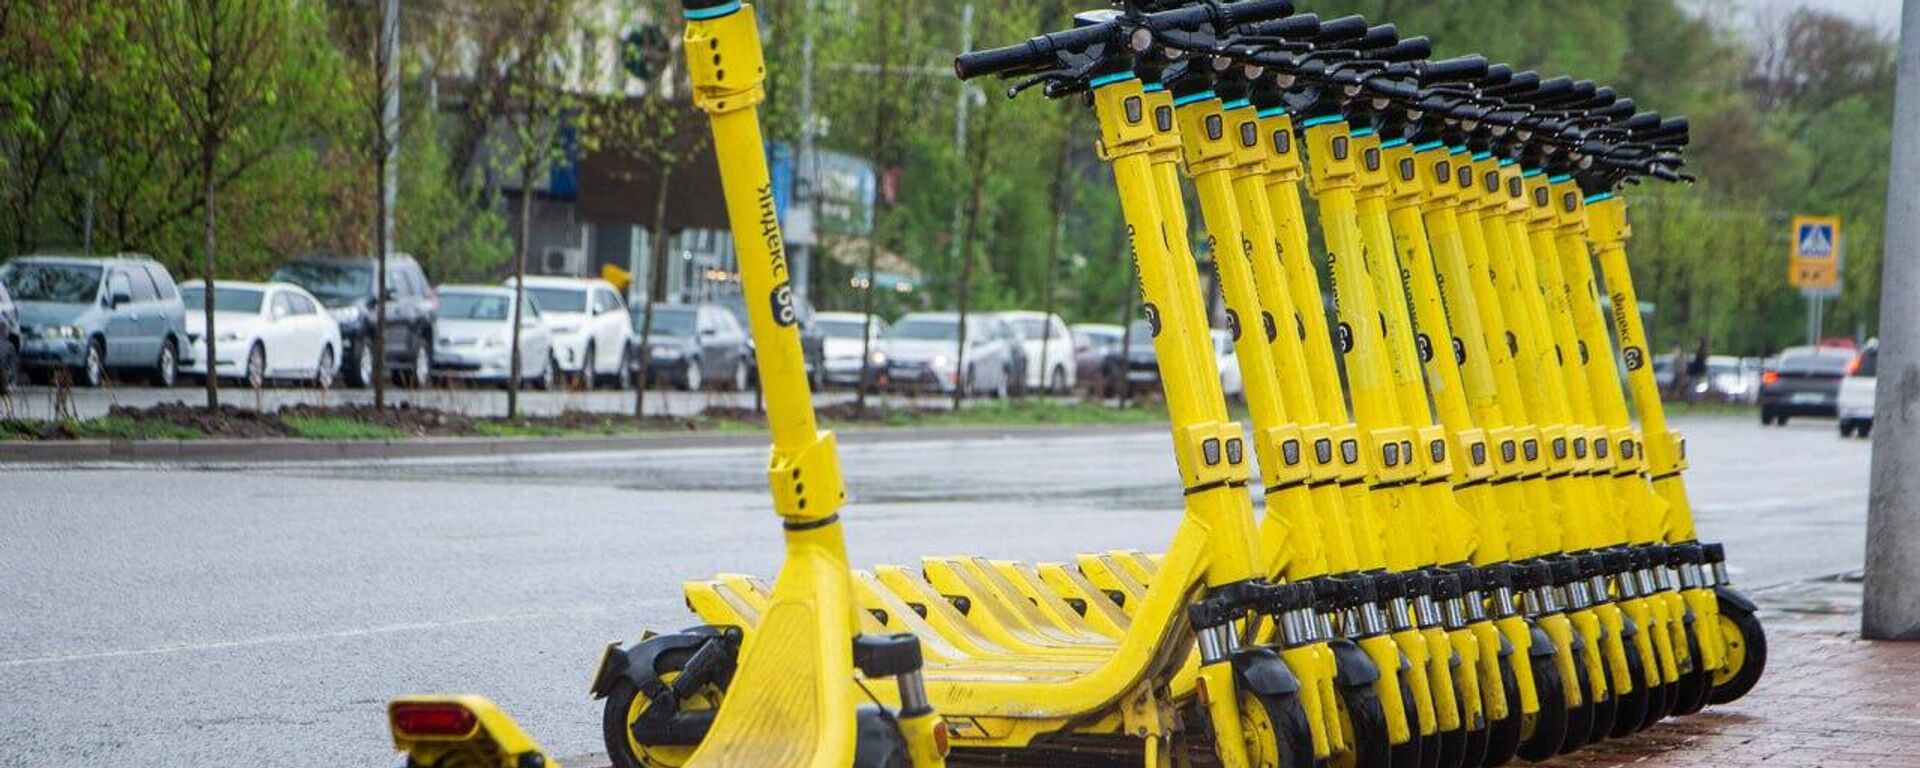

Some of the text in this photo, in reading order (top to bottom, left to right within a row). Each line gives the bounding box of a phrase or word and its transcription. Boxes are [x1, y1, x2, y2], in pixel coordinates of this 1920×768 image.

[757, 183, 794, 323] Яндекс Go
[1611, 291, 1640, 369] Яндекс Go
